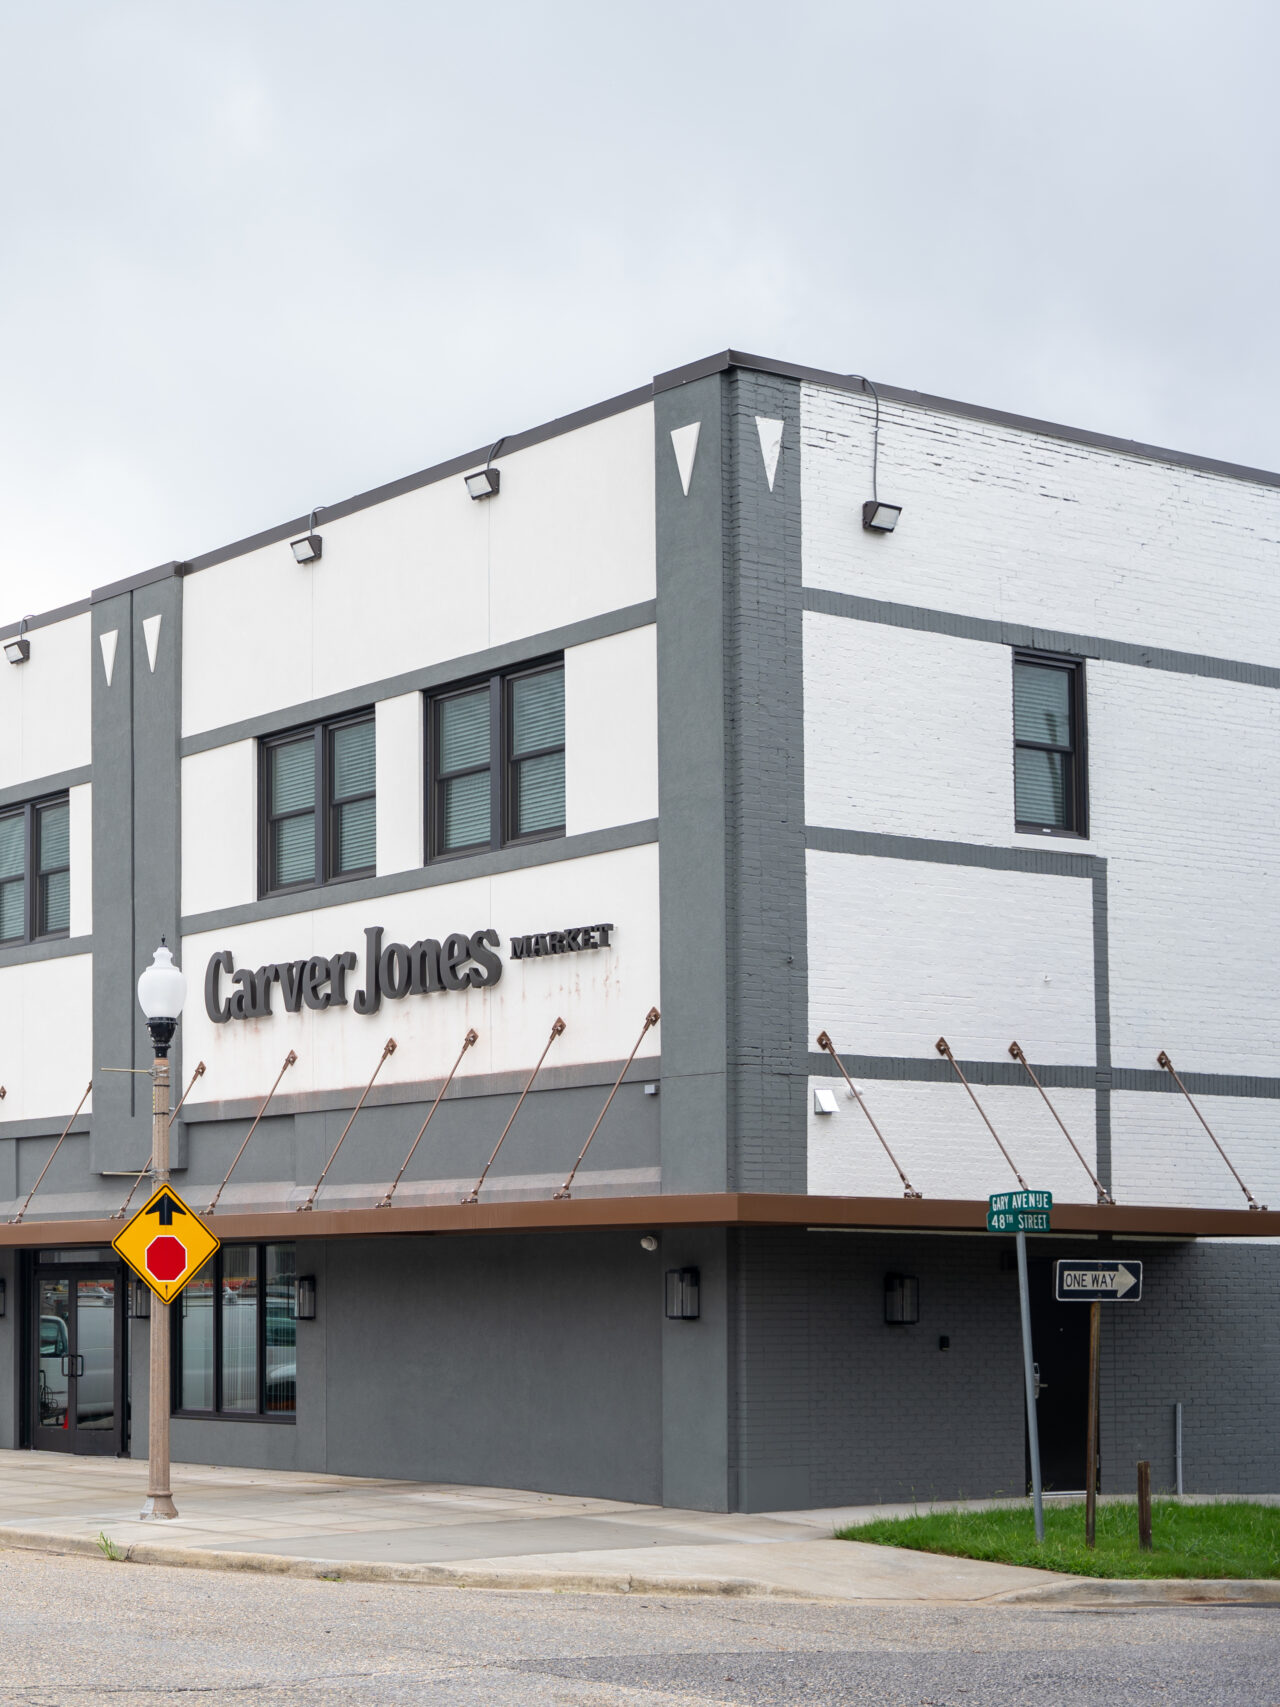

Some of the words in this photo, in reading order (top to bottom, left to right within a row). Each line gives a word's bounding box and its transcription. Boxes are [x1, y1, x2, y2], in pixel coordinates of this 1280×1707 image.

[204, 950, 356, 1023] Carver
[354, 926, 502, 1015] Jones
[509, 923, 614, 959] MARKET
[992, 1196, 1009, 1212] GARY
[1012, 1192, 1049, 1208] AVENUE
[991, 1214, 1013, 1229] 48TH
[1018, 1214, 1047, 1229] STREET
[1065, 1273, 1088, 1288] ONE
[1091, 1273, 1116, 1288] WAY
